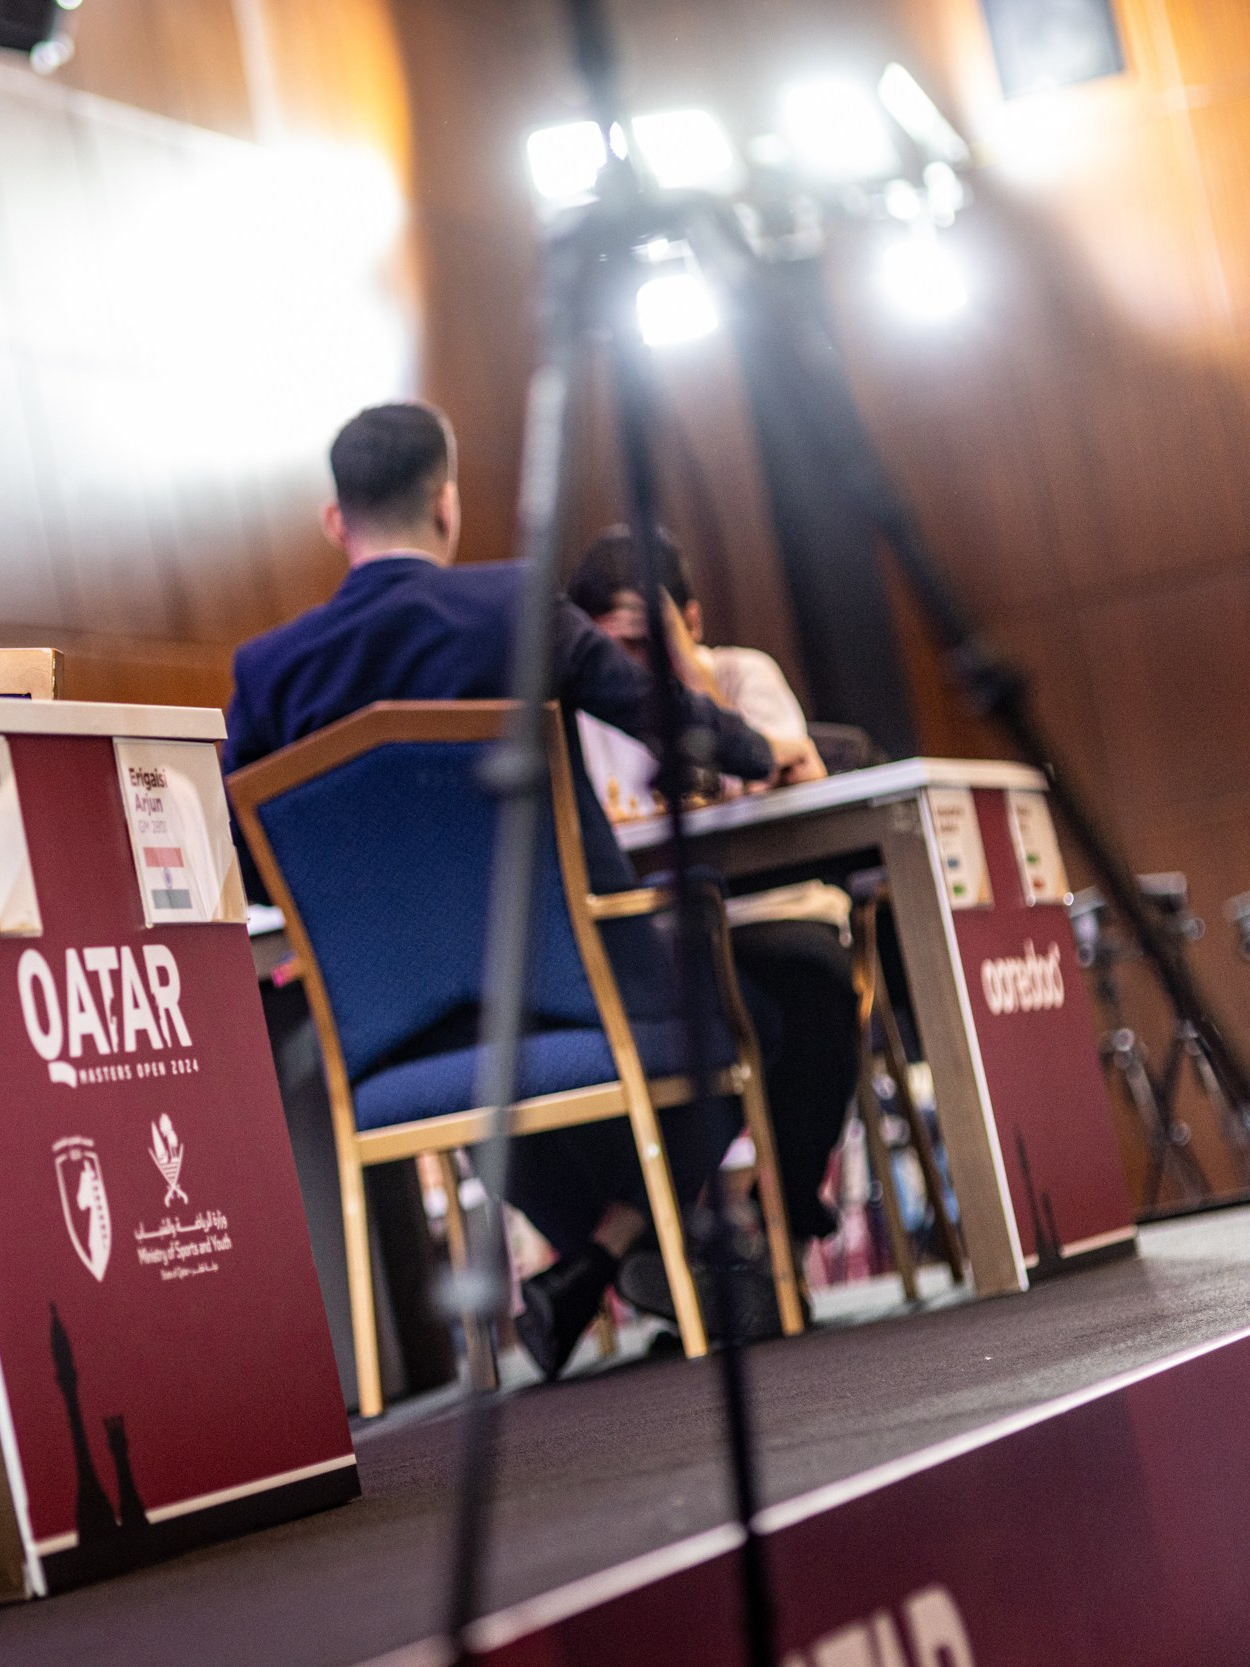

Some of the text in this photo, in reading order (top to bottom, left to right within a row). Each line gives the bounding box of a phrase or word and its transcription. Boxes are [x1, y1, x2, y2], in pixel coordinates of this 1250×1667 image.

[129, 767, 168, 791] Erigaisi
[135, 793, 164, 816] Arjun
[17, 944, 192, 1088] QATAR
[79, 1058, 199, 1084] MASTERS OPEN 2024
